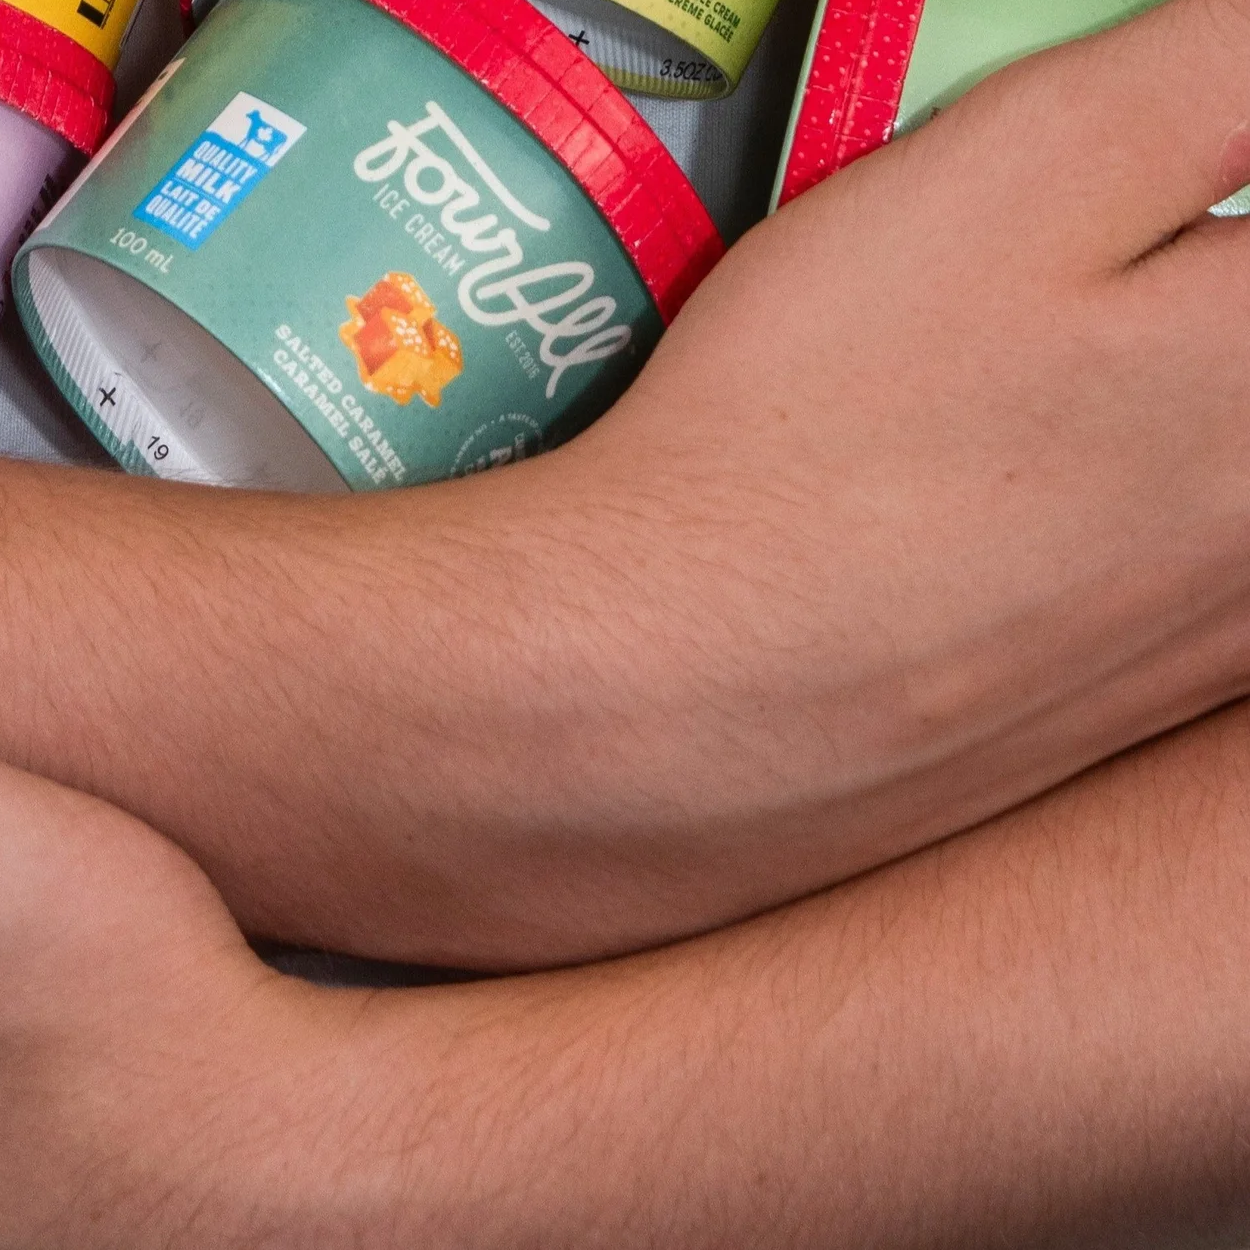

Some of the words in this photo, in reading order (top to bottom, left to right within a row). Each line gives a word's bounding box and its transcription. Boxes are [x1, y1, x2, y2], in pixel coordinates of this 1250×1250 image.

[176, 158, 242, 205] MILK
[194, 141, 258, 183] QUALITY
[146, 195, 208, 240] QUALITÉ
[161, 179, 196, 208] LAIT
[195, 200, 222, 222] DE
[109, 227, 147, 256] 100
[145, 248, 173, 275] mL
[373, 184, 401, 221] ICE
[405, 214, 466, 277] CREAM
[273, 349, 350, 439] CARAMEL
[274, 324, 344, 399] SALTED
[341, 394, 409, 483] CARAMEL
[147, 435, 170, 462] 19
